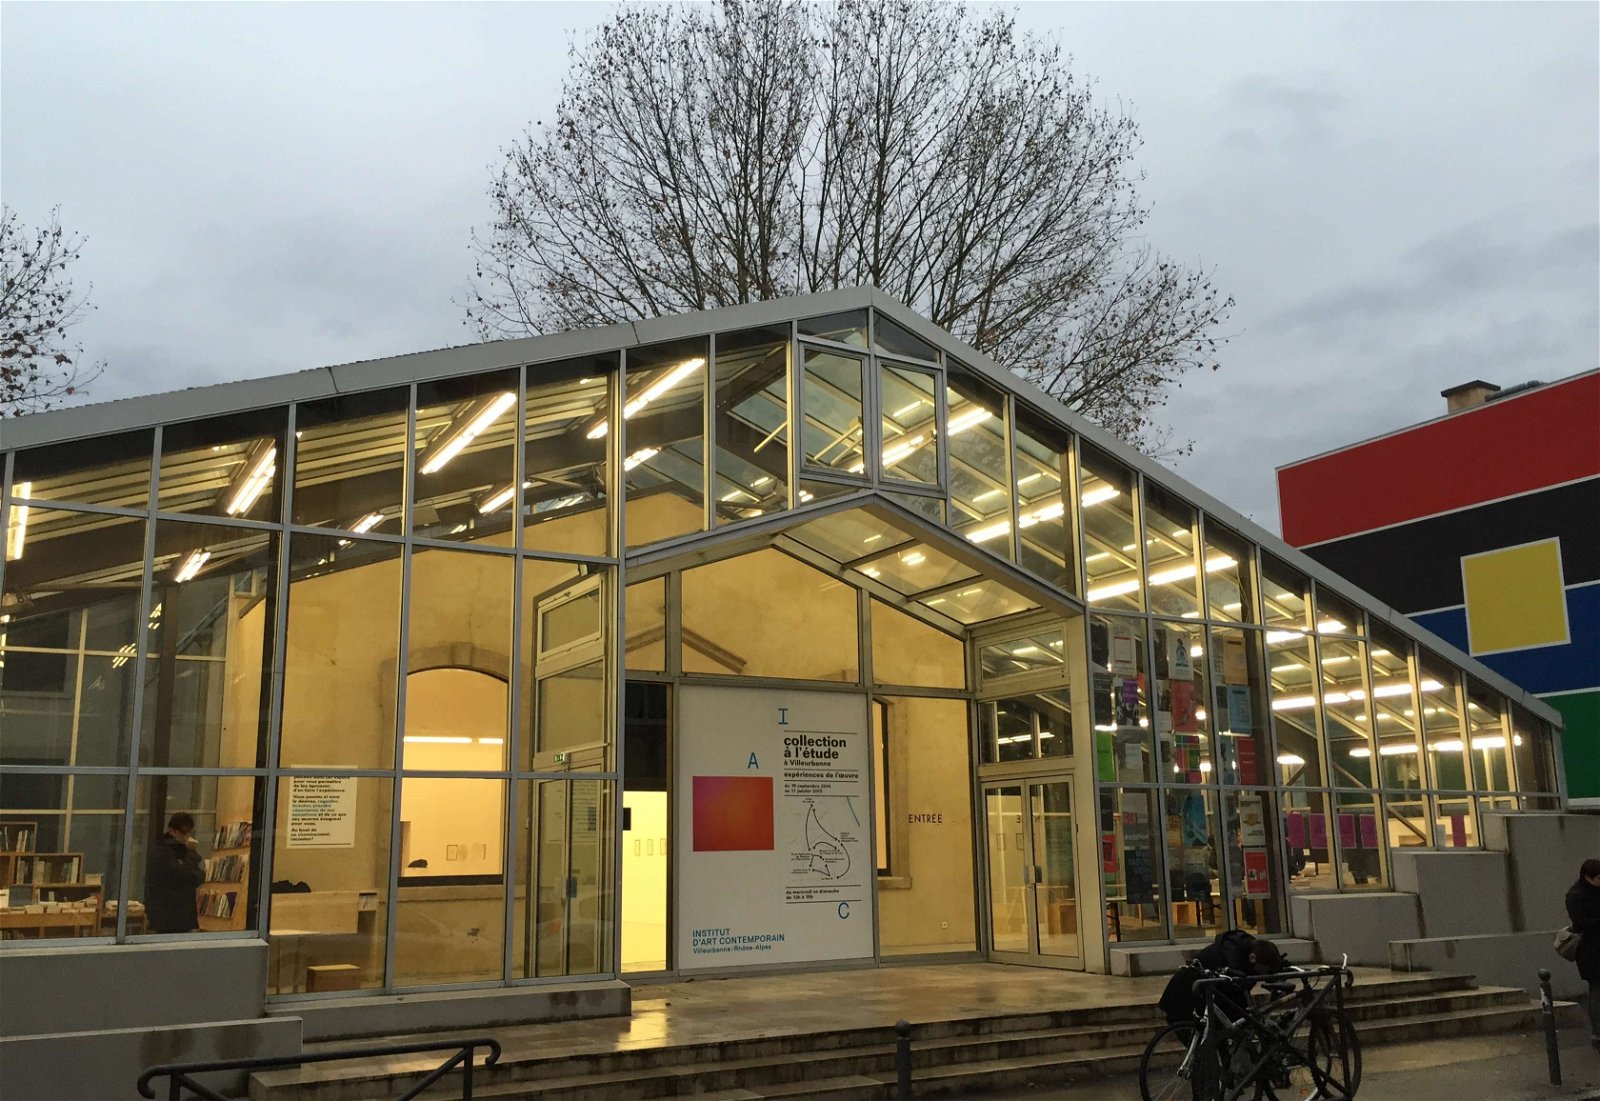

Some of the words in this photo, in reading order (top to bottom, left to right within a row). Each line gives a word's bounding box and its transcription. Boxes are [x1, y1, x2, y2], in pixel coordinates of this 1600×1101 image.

[778, 708, 788, 725] I
[784, 735, 847, 748] collection
[784, 746, 791, 758] à
[795, 747, 839, 759] l'étude
[747, 752, 760, 769] A
[789, 759, 831, 767] Villeurbanne
[838, 902, 850, 919] C
[692, 928, 731, 938] INSTITUT
[692, 938, 718, 947] D'ART
[719, 933, 785, 945] CONTEMPORAIN
